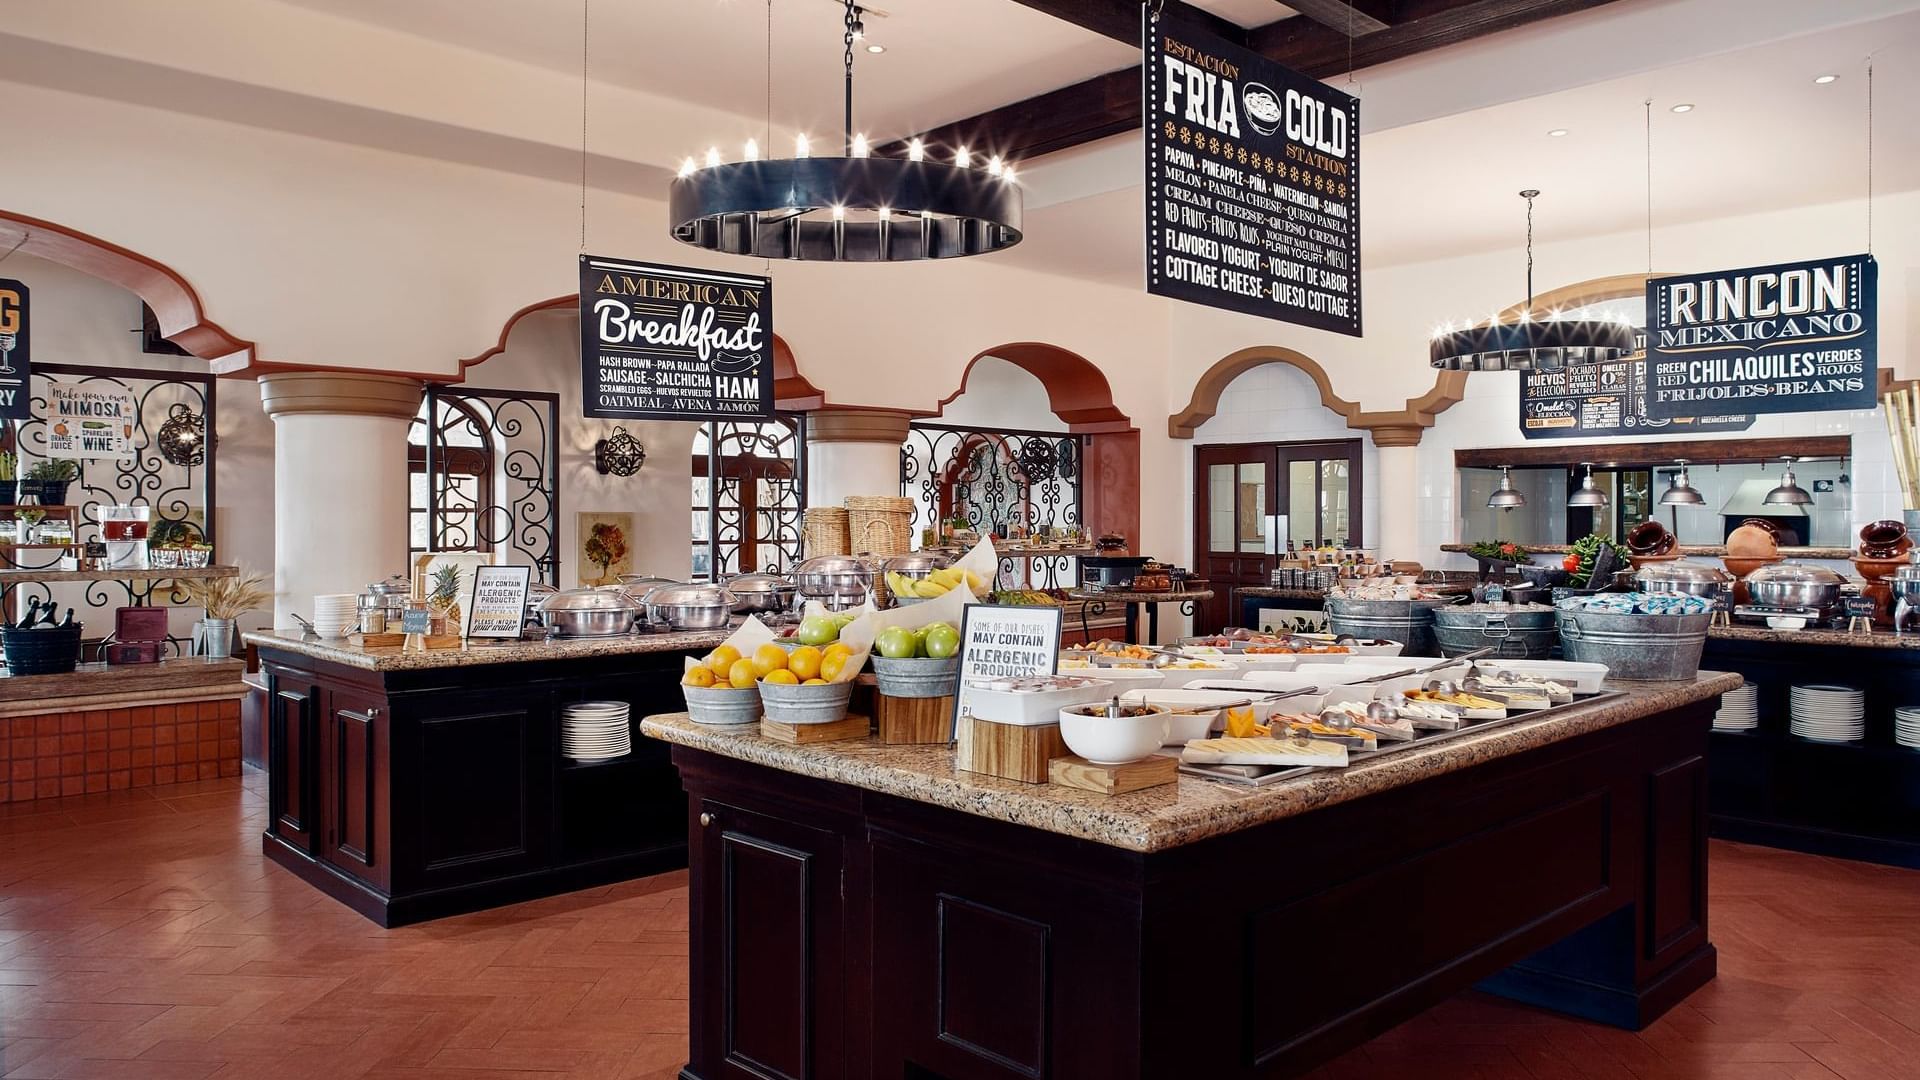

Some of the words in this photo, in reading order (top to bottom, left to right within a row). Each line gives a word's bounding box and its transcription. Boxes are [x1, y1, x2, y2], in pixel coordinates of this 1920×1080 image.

[1164, 36, 1240, 80] ESTACIÓN
[1163, 54, 1241, 139] FRIA
[1286, 88, 1347, 159] COLD
[1165, 145, 1195, 170] PAPAYA
[1286, 143, 1347, 177] STATION
[1165, 165, 1202, 188] MELON
[1208, 180, 1245, 203] PANELA
[1317, 214, 1347, 234] PANELA
[1164, 184, 1212, 210] CREAM
[1309, 228, 1347, 249] CREMA
[1165, 200, 1179, 223] RED
[1240, 222, 1260, 246] ROJOS
[1266, 229, 1293, 245] YOGURT
[1294, 238, 1324, 254] NATURAL
[1266, 239, 1290, 256] PLAIN
[1290, 247, 1323, 264] YOGURT
[1165, 228, 1219, 261] FLAVORED
[1307, 266, 1319, 286] DE
[1320, 270, 1348, 294] SABOR
[595, 273, 762, 309] AMERICAN
[1165, 255, 1219, 289] COTTAGE
[1308, 289, 1349, 318] COTTAGE
[1669, 264, 1847, 327] RINCON
[594, 298, 763, 361] Breakfast
[1657, 312, 1862, 348] MEXICANO
[599, 355, 621, 367] HASH
[677, 360, 710, 373] RALLADA
[1656, 361, 1687, 375] GREEN
[1816, 349, 1862, 363] VERDES
[1689, 352, 1816, 384] CHILAQUILES
[715, 375, 760, 400] HAM
[1527, 373, 1566, 387] HUEVOS
[1656, 375, 1687, 387] RED
[1817, 363, 1863, 376] ROJOS
[52, 387, 79, 400] Make
[82, 391, 105, 404] your
[108, 394, 129, 404] own
[599, 384, 636, 394] SCRAMBLED
[680, 388, 712, 398] REVUELTOS
[59, 400, 122, 417] MIMOSA
[716, 401, 760, 413] JAMÓN
[1535, 400, 1565, 413] Omelet
[50, 441, 73, 450] JUICE
[478, 589, 522, 597] ALERGENIC
[972, 632, 996, 645] MAY
[998, 633, 1044, 647] CONTAIN
[973, 621, 990, 632] SOME
[993, 622, 1002, 633] OF
[1004, 623, 1018, 634] OUR
[1021, 623, 1045, 635] DISHES
[967, 648, 1047, 667] ALERGENIC
